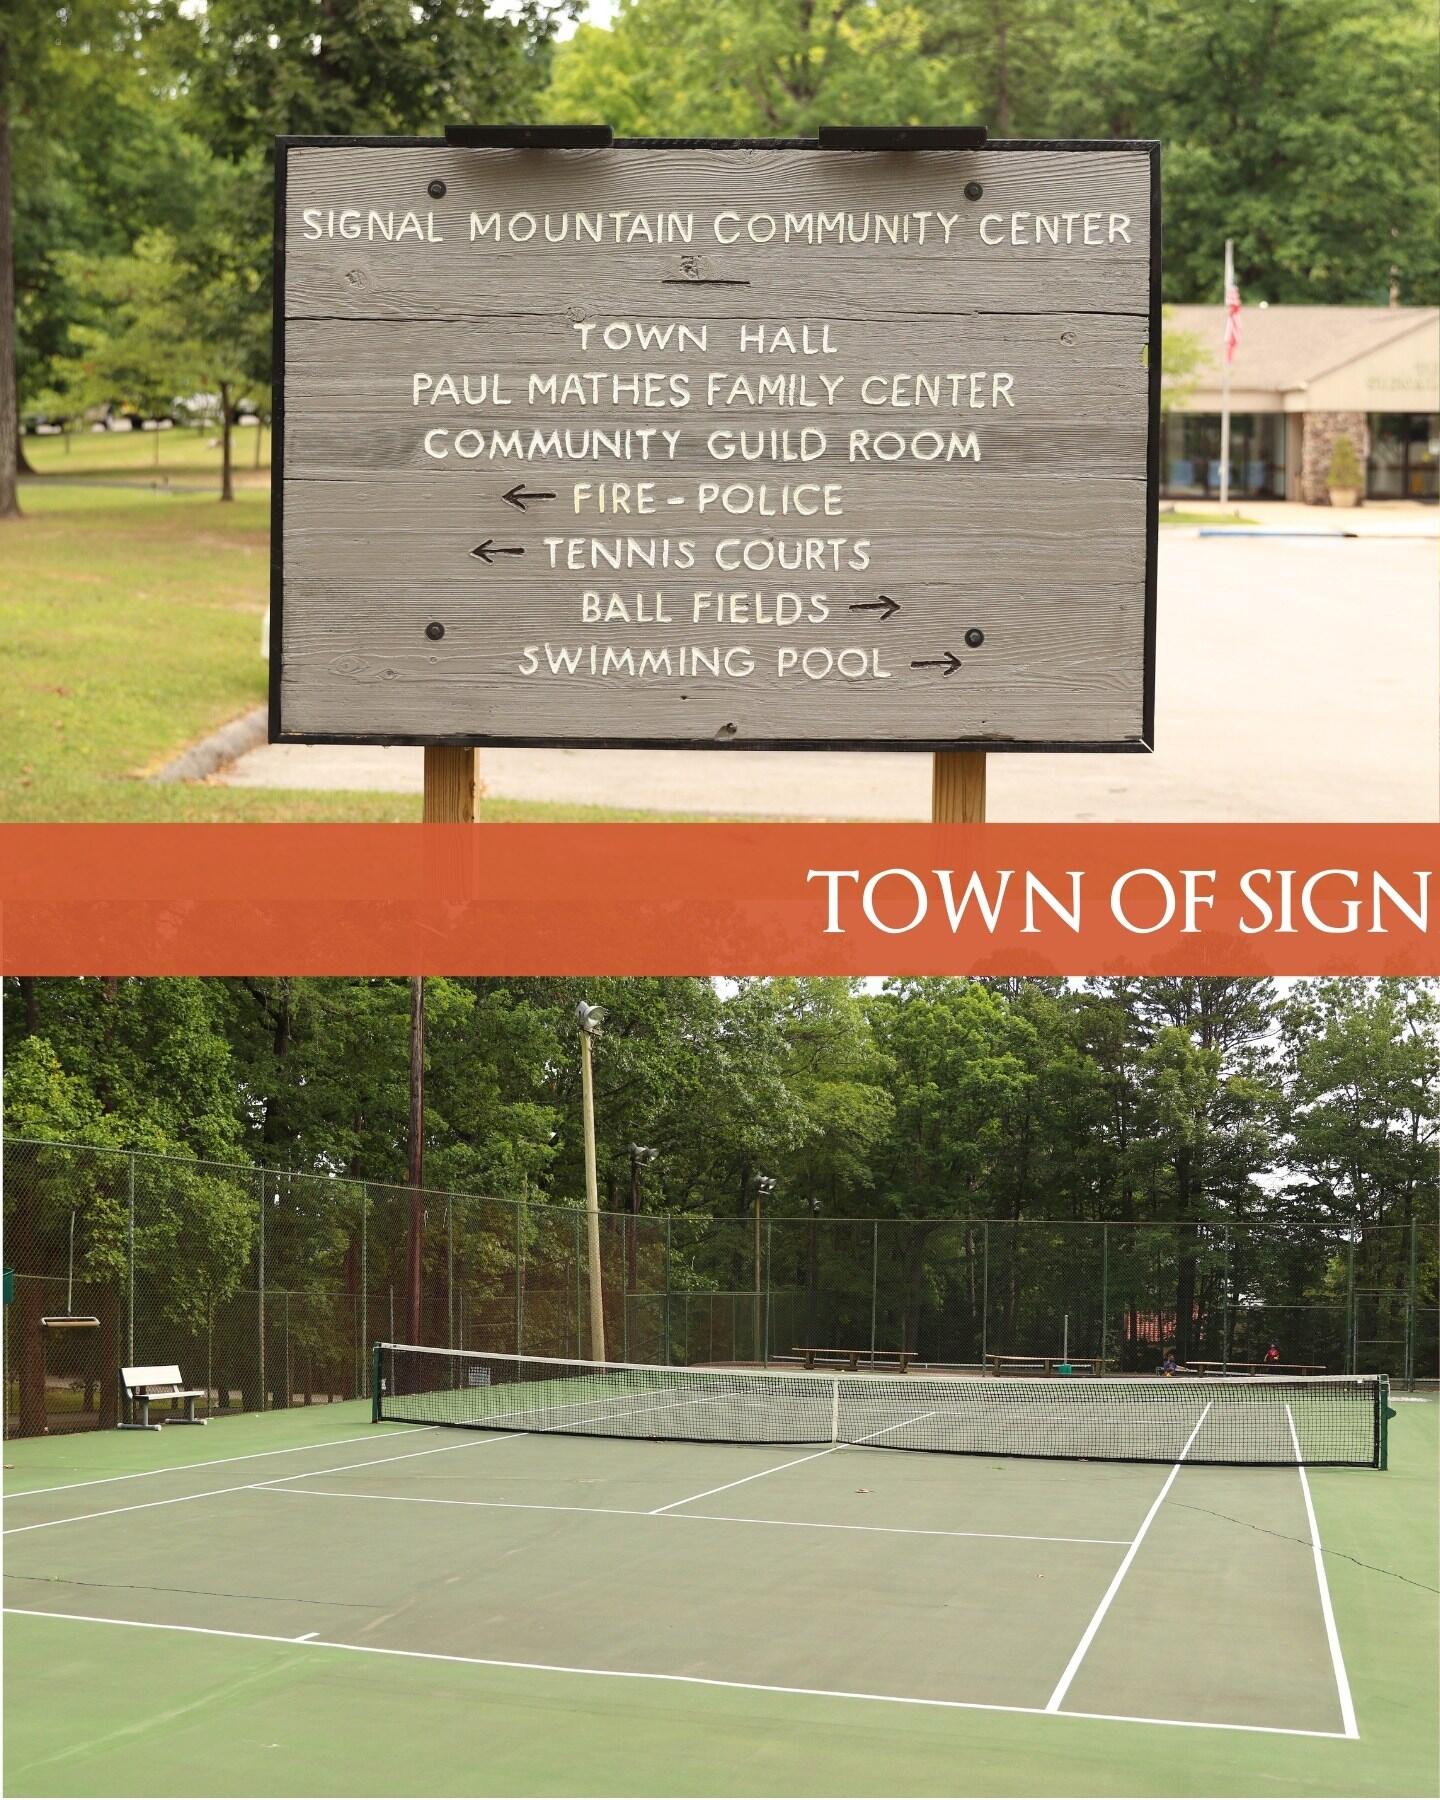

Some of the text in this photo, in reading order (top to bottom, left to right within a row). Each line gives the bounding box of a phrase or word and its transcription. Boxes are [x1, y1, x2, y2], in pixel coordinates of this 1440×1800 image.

[302, 208, 1135, 247] SIGNAL MOUNTAIN COMMUNITY CENTER
[574, 322, 837, 354] TOWN HALL
[413, 371, 1014, 410] PAUL MATHES FAMILY CENTER
[425, 427, 981, 464] COMMUNITY GUILD ROOM
[544, 537, 870, 573] TENNIS COURTS
[583, 592, 834, 626] BALL FIELDS
[519, 643, 891, 680] SWIMMING POOL
